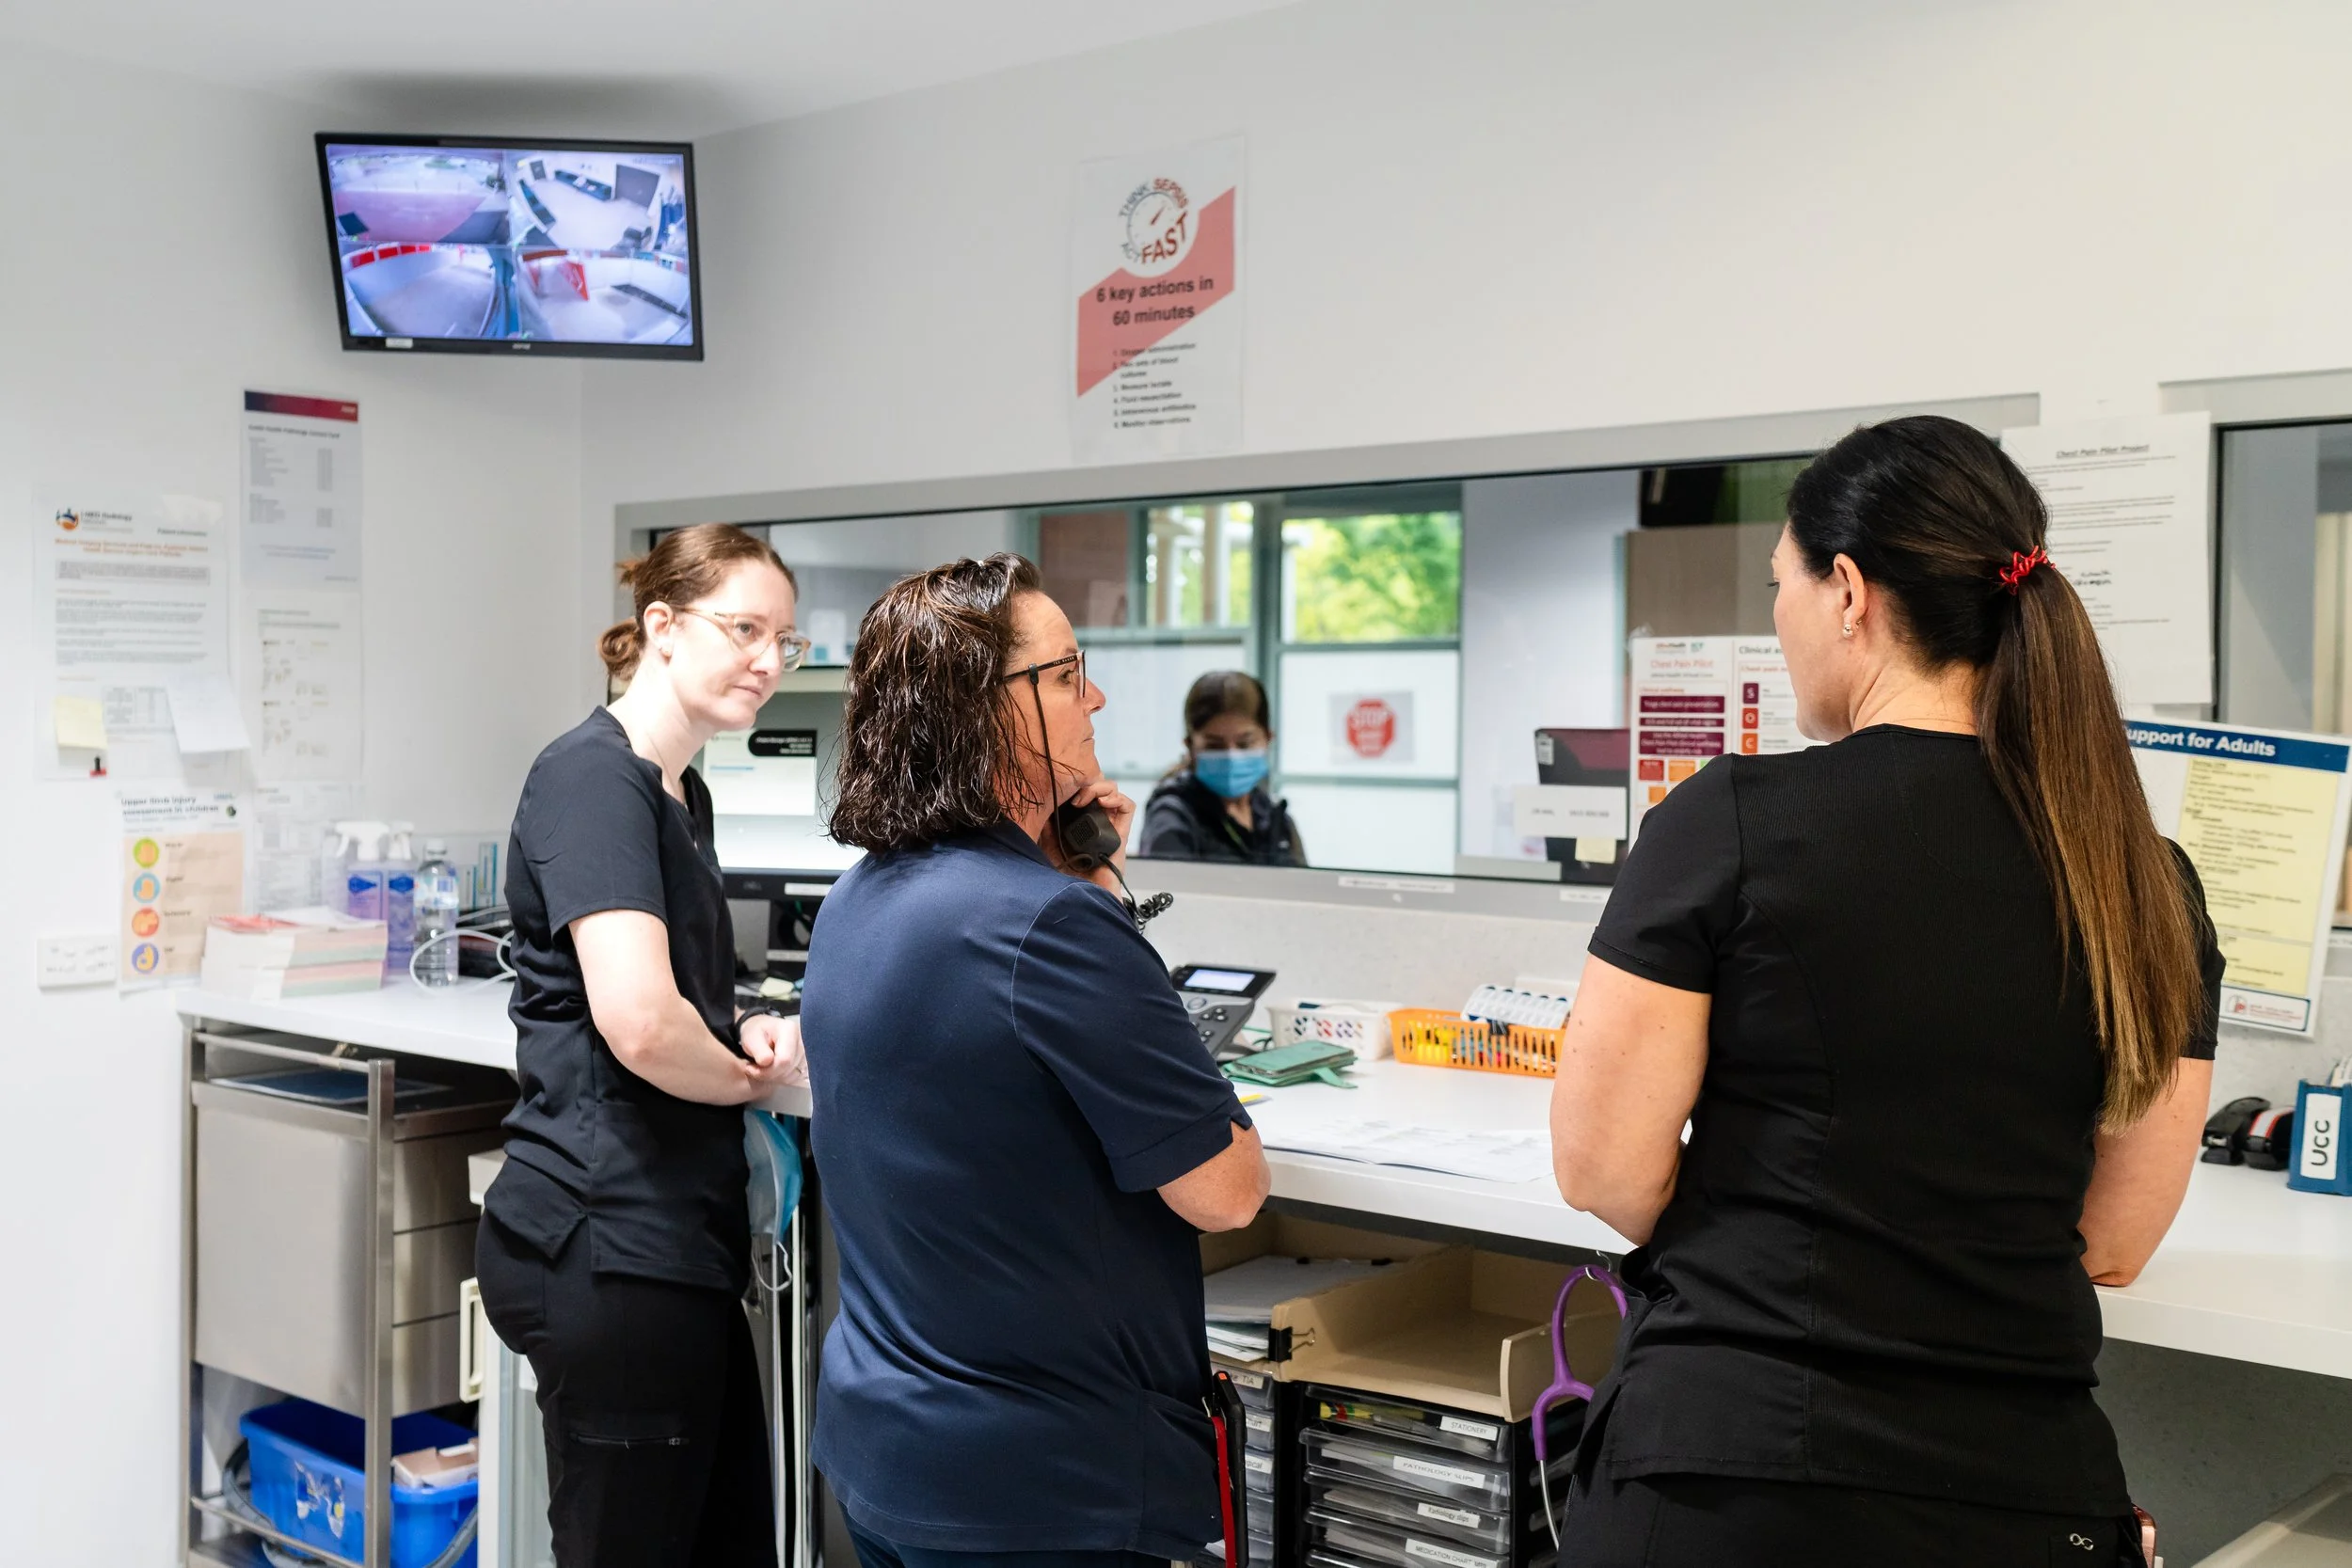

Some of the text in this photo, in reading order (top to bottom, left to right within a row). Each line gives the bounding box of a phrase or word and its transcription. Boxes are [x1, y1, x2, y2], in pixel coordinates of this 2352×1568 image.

[1119, 182, 1150, 217] THINK
[1141, 210, 1187, 264] FAST
[1096, 276, 1214, 304] 6 key actions in
[1113, 306, 1195, 325] 60 minutes
[1739, 645, 1771, 655] Clinical
[1352, 710, 1389, 726] STOP
[1745, 737, 1755, 749] C
[2126, 728, 2276, 756] upport for Adults
[2311, 1119, 2330, 1166] UCC
[1242, 1374, 1255, 1385] TIA
[1451, 1421, 1487, 1433] STATIONERY
[1403, 1462, 1475, 1482] PATHOLOGY SLIPS
[1415, 1545, 1472, 1564] MEDICATION CHART
